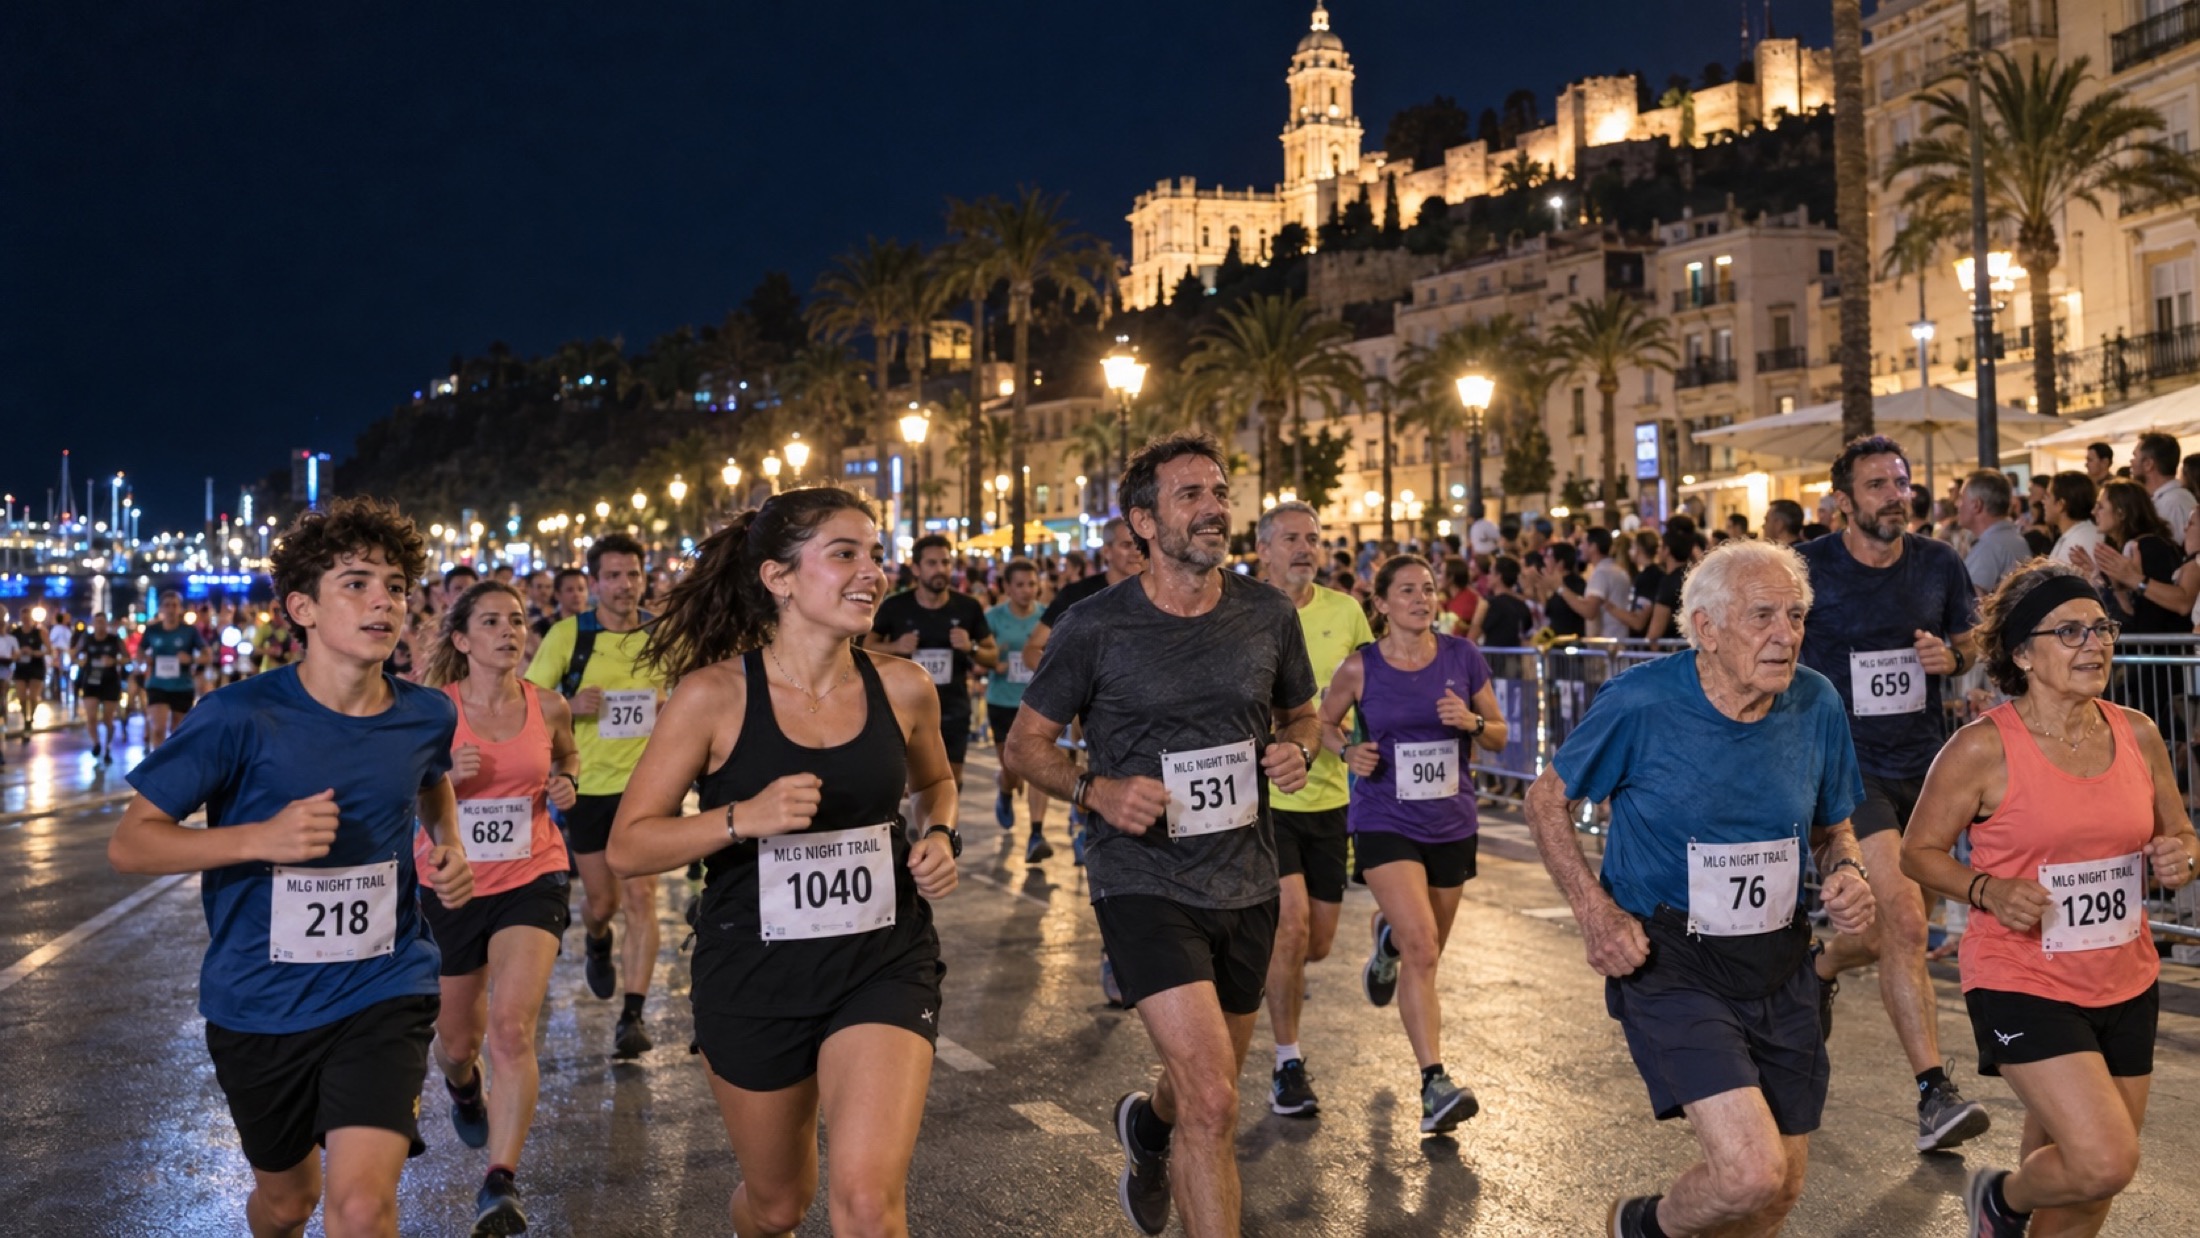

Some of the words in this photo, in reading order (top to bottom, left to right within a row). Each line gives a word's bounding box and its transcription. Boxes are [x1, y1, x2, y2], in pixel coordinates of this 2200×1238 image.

[1871, 671, 1910, 697] 659
[612, 705, 643, 725] 376
[1174, 761, 1194, 774] MLG
[1196, 756, 1223, 771] NIGHT
[1225, 751, 1248, 765] TRAIL
[1412, 761, 1446, 784] 904
[1190, 774, 1236, 812] 531
[472, 820, 514, 844] 682
[774, 846, 802, 862] MLG
[805, 842, 843, 860] NIGHT
[847, 838, 881, 855] TRAIL
[1703, 855, 1726, 868] MLG
[1729, 853, 1760, 867] NIGHT
[1763, 850, 1788, 864] TRAIL
[286, 878, 313, 893] MLG
[316, 878, 352, 893] NIGHT
[356, 874, 386, 890] TRAIL
[787, 865, 872, 910] 1040
[2052, 874, 2076, 888] MLG
[2078, 870, 2107, 885] NIGHT
[2110, 865, 2135, 880] TRAIL
[1729, 874, 1766, 910] 76
[305, 899, 369, 938] 218
[2062, 888, 2127, 927] 1298
